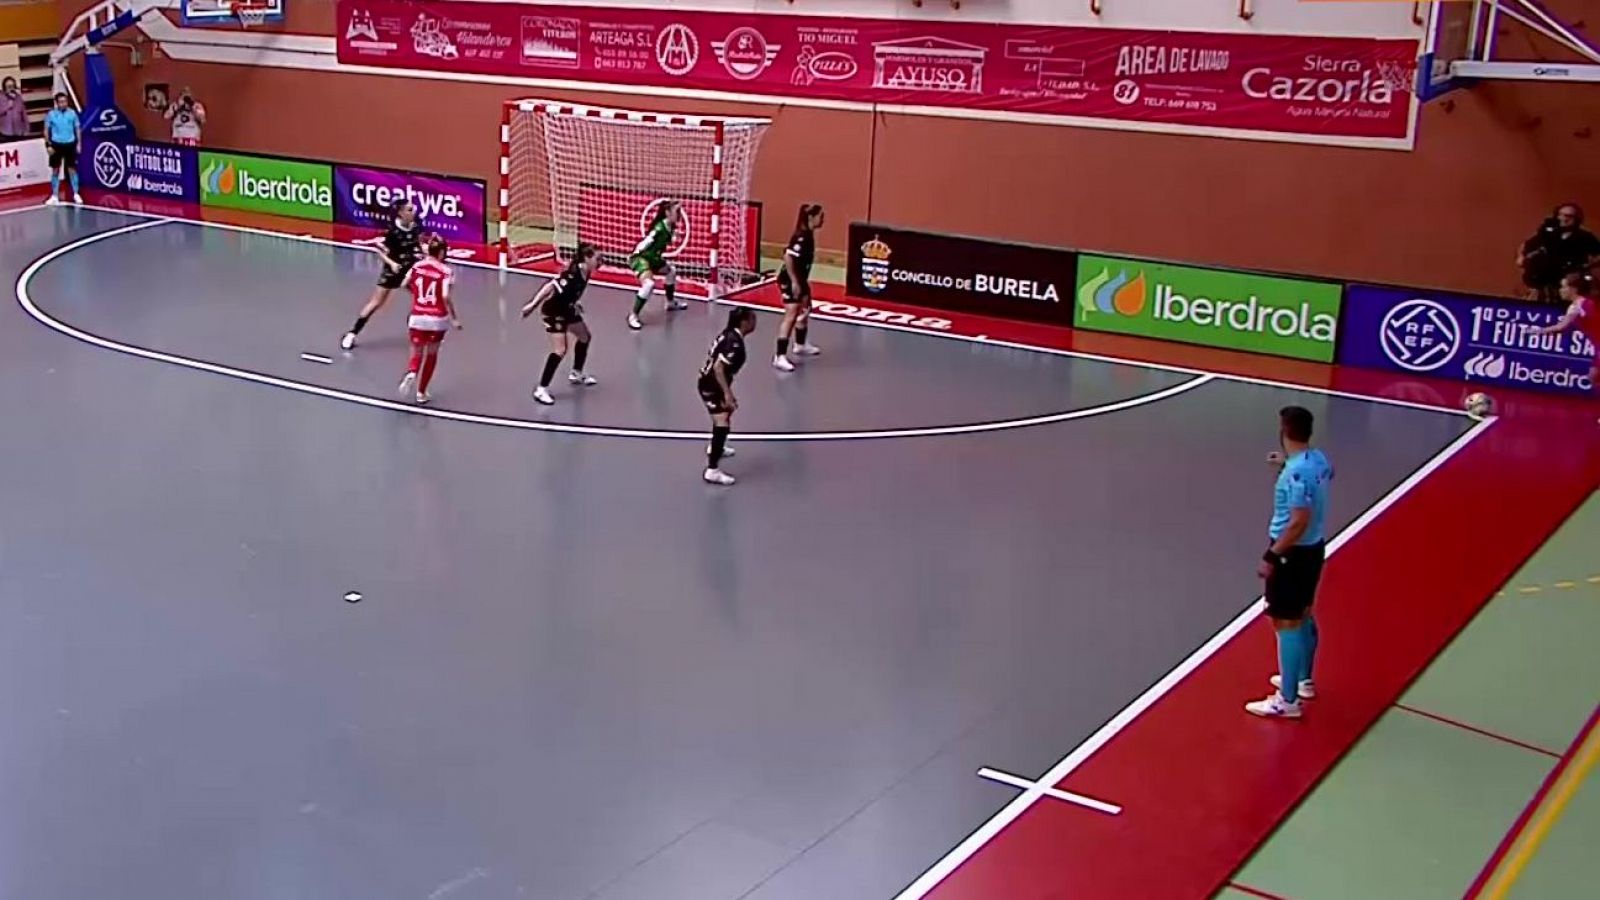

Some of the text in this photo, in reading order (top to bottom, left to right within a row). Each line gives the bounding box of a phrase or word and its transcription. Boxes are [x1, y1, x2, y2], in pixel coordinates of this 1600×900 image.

[590, 31, 634, 46] ARTEAGA
[818, 33, 858, 46] MIGUEL
[891, 66, 966, 86] AYUSO
[1115, 45, 1230, 78] AREA DE LAVADO
[1303, 54, 1361, 73] Sierra
[1241, 67, 1392, 104] Cazorla
[144, 178, 183, 196] Iberdrola
[238, 169, 332, 207] Iberdrola
[415, 277, 438, 306] 14
[891, 268, 1060, 303] CONCELLO DE BURELA
[1153, 283, 1338, 342] Iberdrola
[1568, 330, 1596, 357] SA
[1508, 360, 1593, 391] Iberdro
